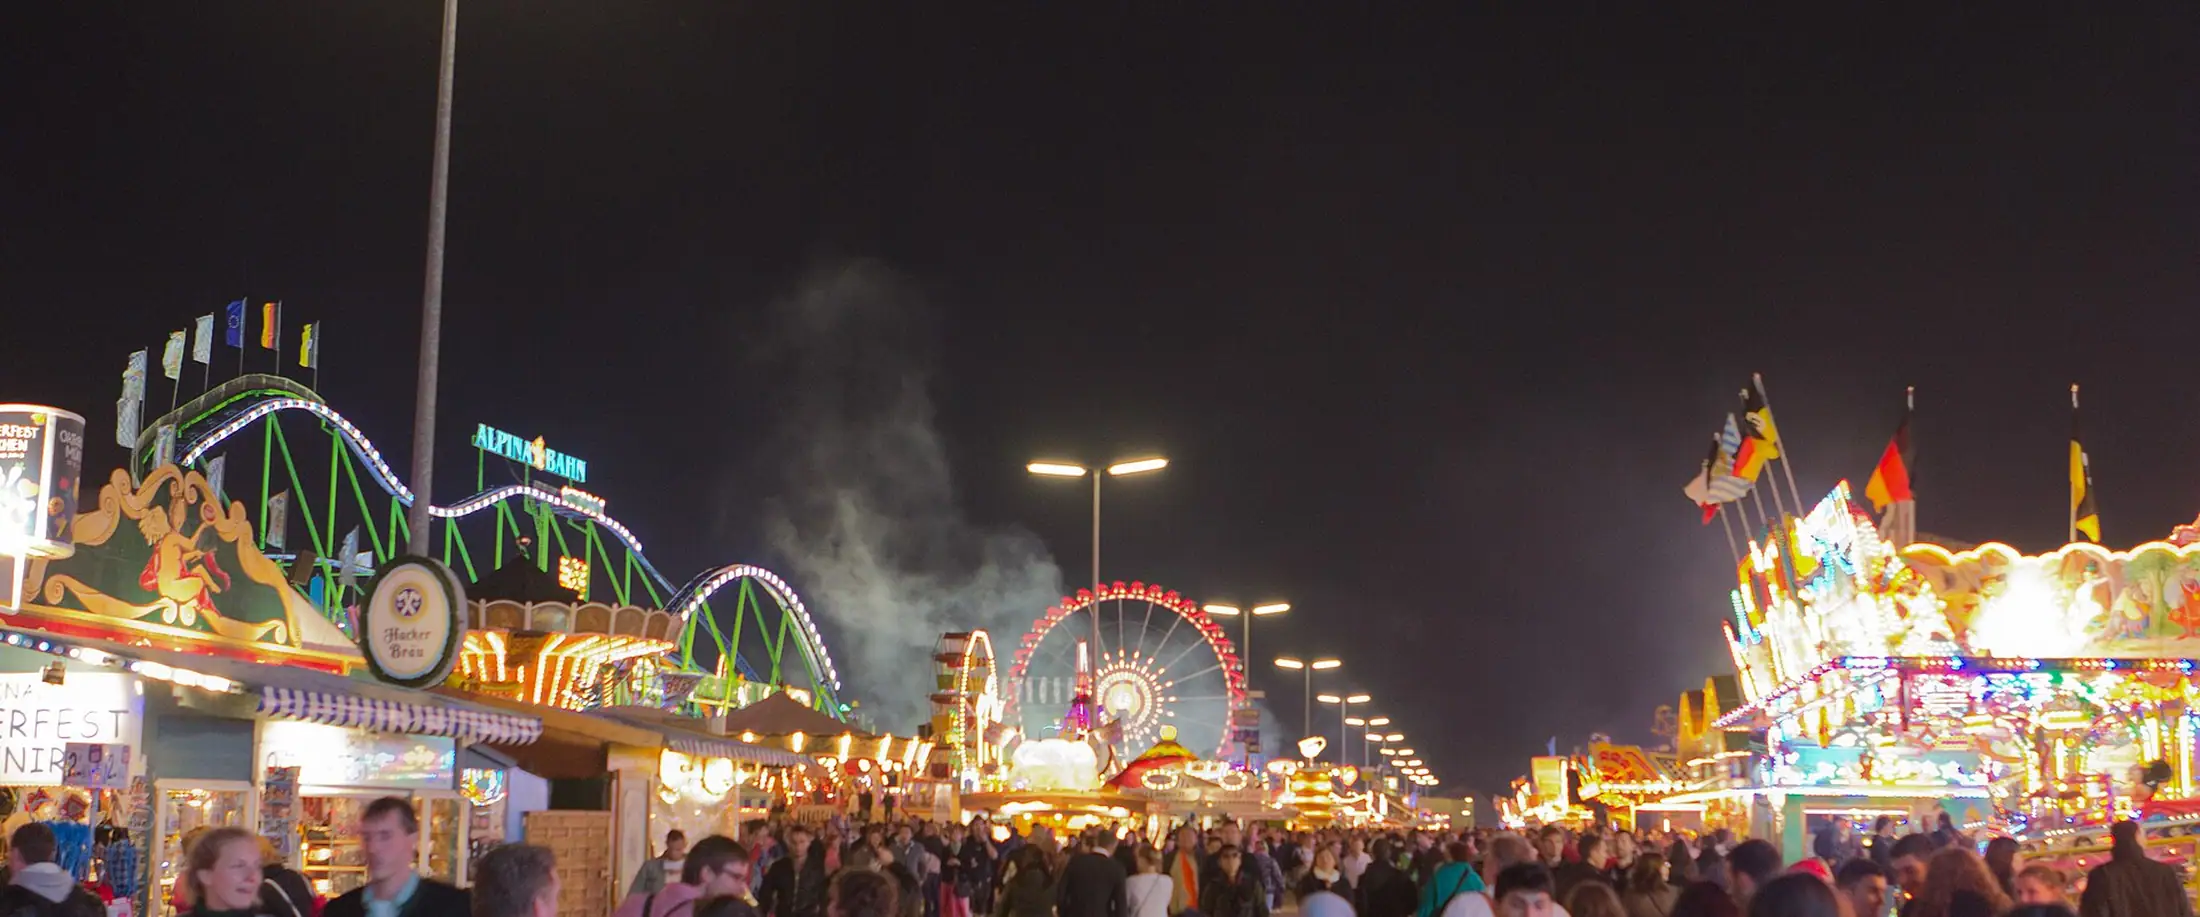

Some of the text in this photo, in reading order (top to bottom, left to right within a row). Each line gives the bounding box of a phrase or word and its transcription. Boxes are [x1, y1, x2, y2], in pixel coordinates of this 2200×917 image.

[475, 423, 587, 483] ALPINA BAHN
[384, 627, 431, 643] Hacker
[390, 643, 424, 659] Bräu
